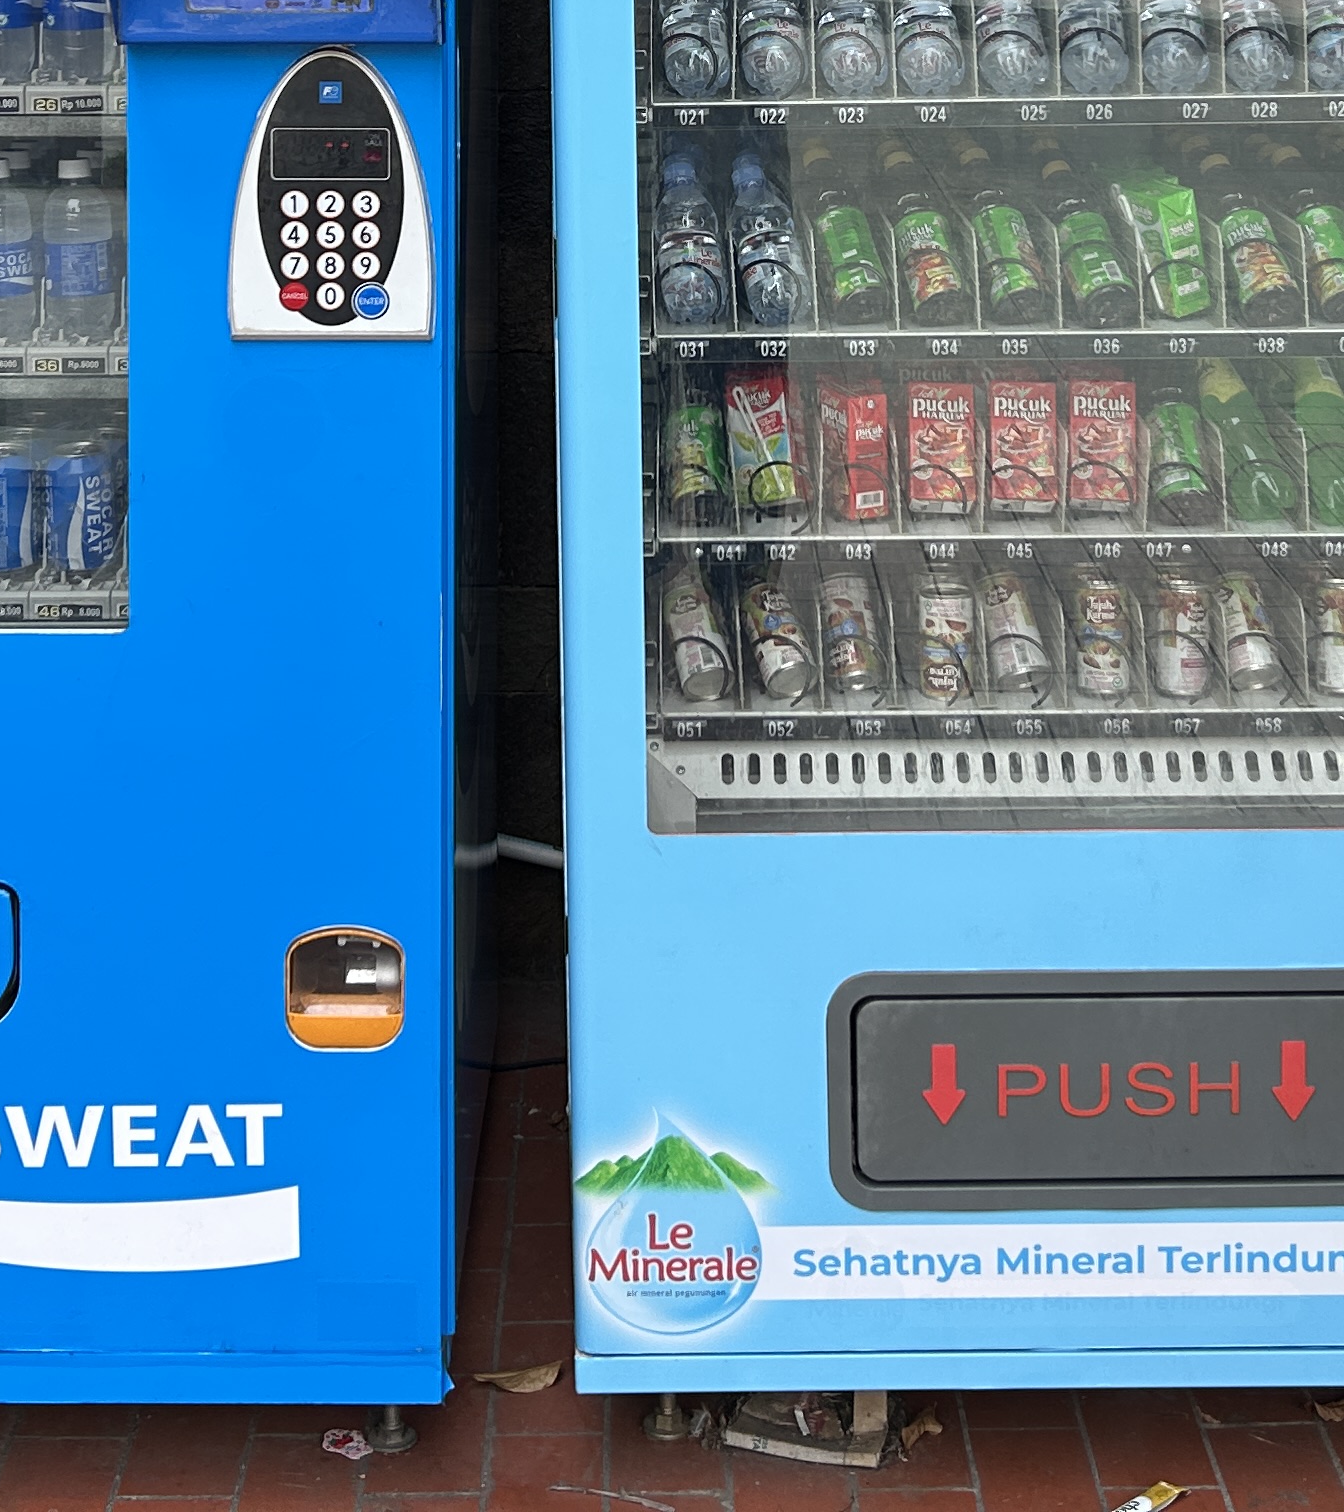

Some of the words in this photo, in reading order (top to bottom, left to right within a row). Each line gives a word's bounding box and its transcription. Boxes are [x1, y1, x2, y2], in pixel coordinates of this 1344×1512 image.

[35, 99, 57, 112] 26
[1085, 103, 1113, 120] 026
[1251, 101, 1278, 118] 028
[679, 109, 705, 126] 021
[759, 108, 786, 125] 022
[838, 107, 865, 124] 023
[920, 106, 947, 123] 024
[290, 195, 298, 213] 1
[324, 195, 336, 213] 2
[360, 195, 372, 213] 3
[287, 225, 301, 243] 4
[325, 225, 336, 243] 5
[360, 225, 372, 244] 6
[289, 256, 301, 275] 7
[324, 256, 336, 275] 8
[360, 256, 372, 275] 9
[324, 287, 336, 305] 0
[358, 296, 385, 306] ENTER
[679, 341, 704, 358] 031
[760, 340, 787, 357] 032
[849, 339, 876, 356] 033
[931, 339, 958, 356] 034
[1002, 338, 1029, 355] 035
[1093, 337, 1121, 355] 036
[1258, 337, 1285, 354] 038
[36, 361, 58, 373] 36
[912, 396, 970, 418] pucuk
[993, 395, 1052, 417] pucuk
[1073, 394, 1131, 417] pucuk
[716, 545, 743, 561] 041
[769, 544, 796, 561] 042
[845, 543, 872, 560] 043
[929, 542, 955, 559] 044
[1006, 542, 1033, 559] 045
[1261, 541, 1288, 558] 048
[677, 721, 703, 738] 051
[768, 721, 794, 738] 052
[855, 720, 882, 737] 053
[1016, 719, 1043, 736] 055
[996, 1059, 1242, 1120] PUSH
[647, 1213, 694, 1251] Le
[588, 1246, 758, 1283] Minerale
[792, 1247, 984, 1281] Sehatnya
[996, 1243, 1147, 1276] Mineral
